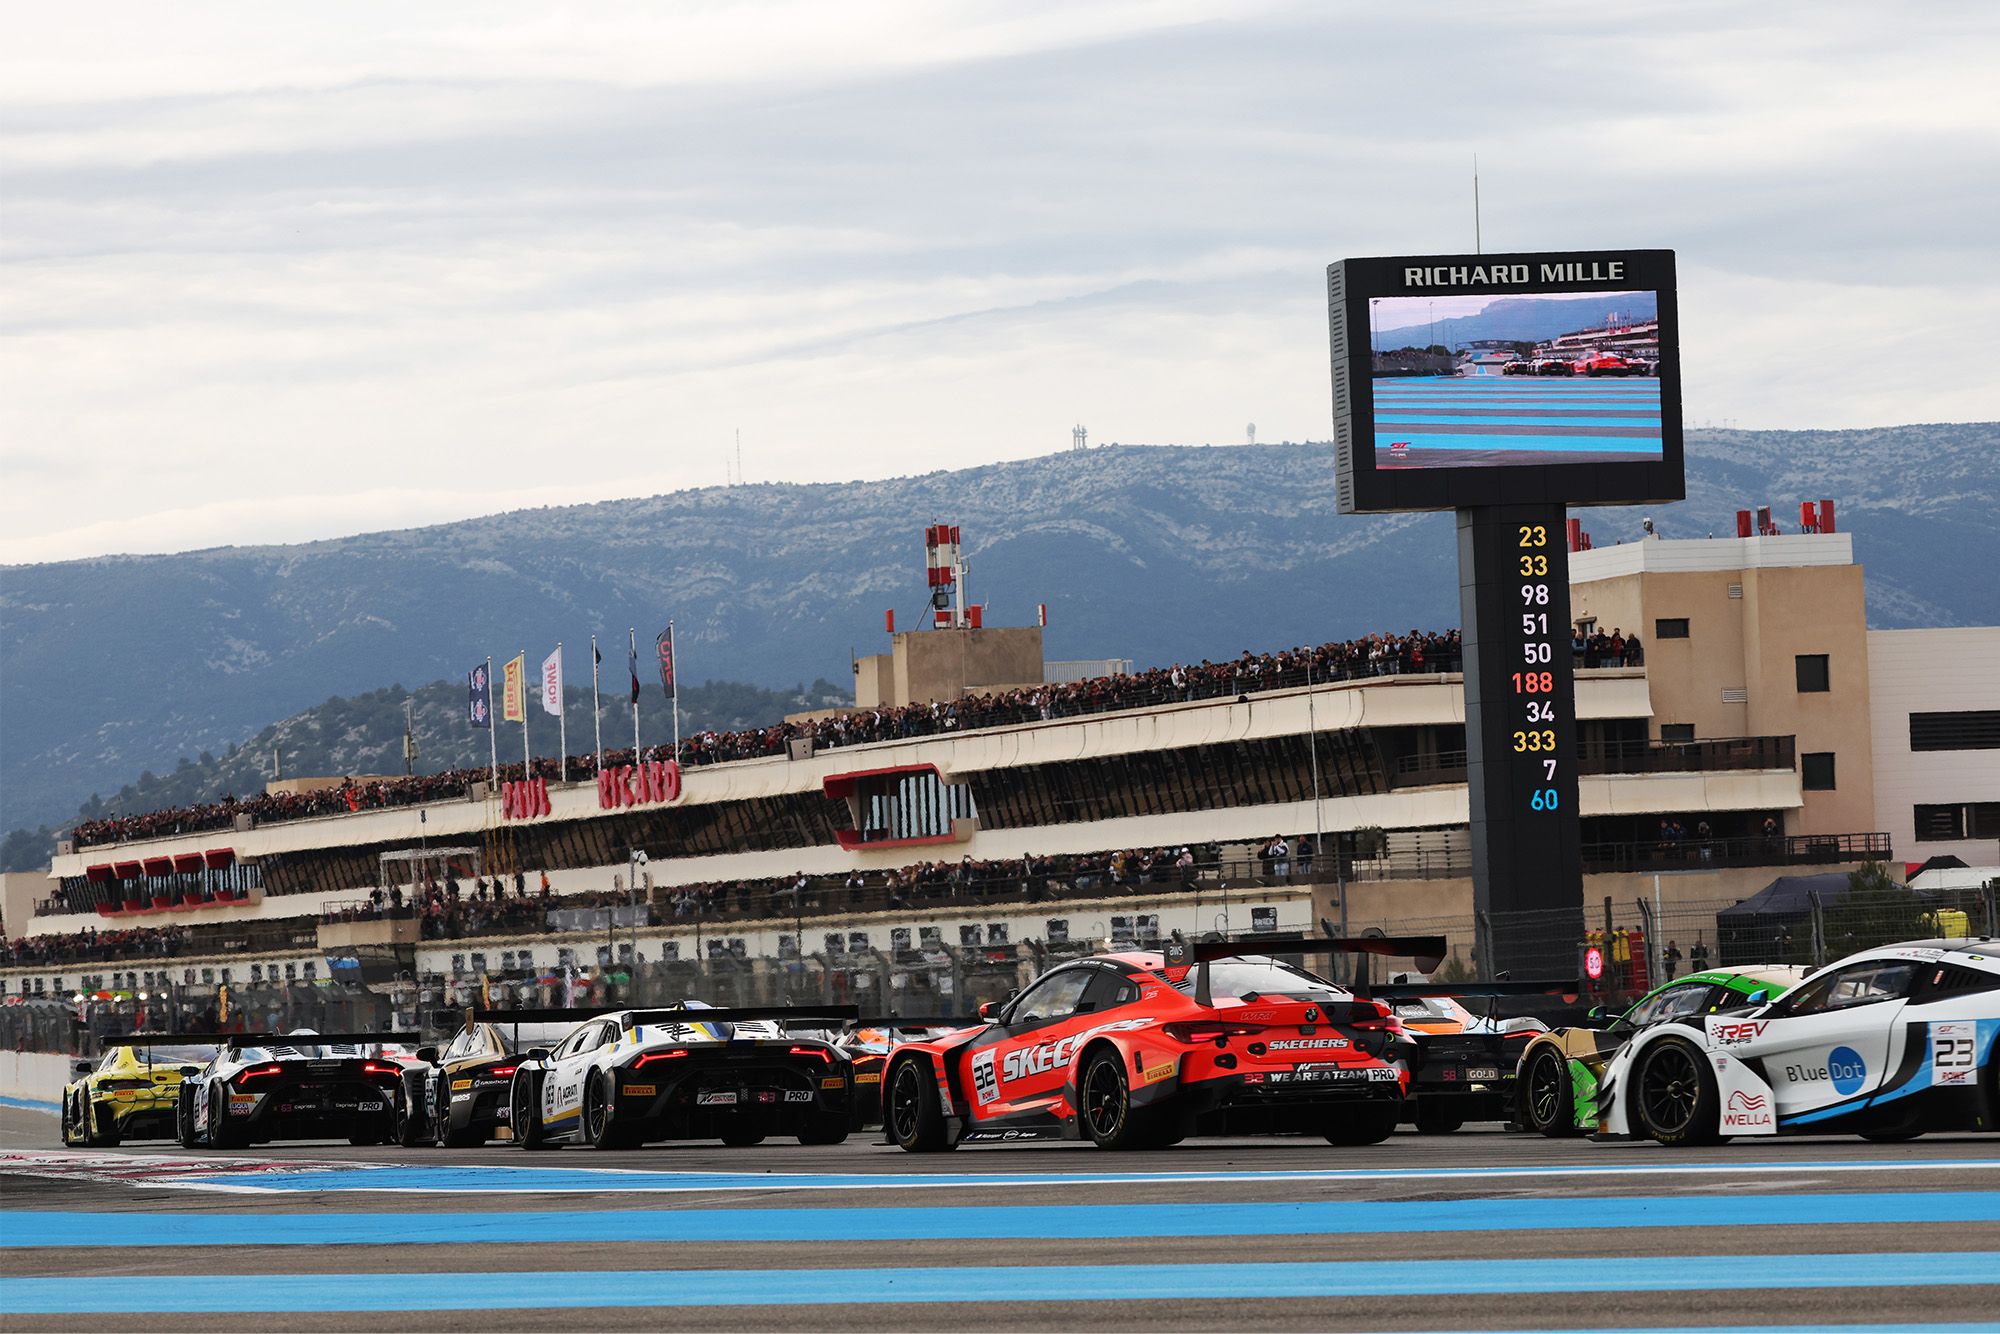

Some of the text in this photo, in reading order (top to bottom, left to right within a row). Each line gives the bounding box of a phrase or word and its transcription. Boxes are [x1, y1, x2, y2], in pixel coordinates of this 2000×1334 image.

[1404, 261, 1624, 286] RICHARD MILLE
[1518, 525, 1547, 547] 23
[1519, 554, 1548, 577] 33
[1520, 584, 1549, 606] 98
[1522, 613, 1548, 635] 51
[1524, 642, 1552, 665] 50
[1512, 671, 1553, 694] 188
[1526, 701, 1555, 722] 34
[1513, 730, 1556, 752] 333
[1543, 759, 1557, 781] 7
[502, 759, 681, 820] PAUL RICARD
[1530, 788, 1559, 811] 60
[1719, 1020, 1770, 1038] REV
[1269, 1038, 1348, 1050] SKECHERS
[1718, 1037, 1752, 1045] COMPS
[1935, 1039, 1973, 1067] 23
[973, 1061, 996, 1091] 32
[1146, 1064, 1173, 1081] PIRELLI
[1244, 1073, 1264, 1083] 32
[1271, 1070, 1367, 1082] WE ARE A TEAM
[1373, 1069, 1395, 1081] PRO
[1469, 1069, 1495, 1079] GOLD
[788, 1091, 808, 1101] PRO
[1723, 1113, 1771, 1126] WELLA
